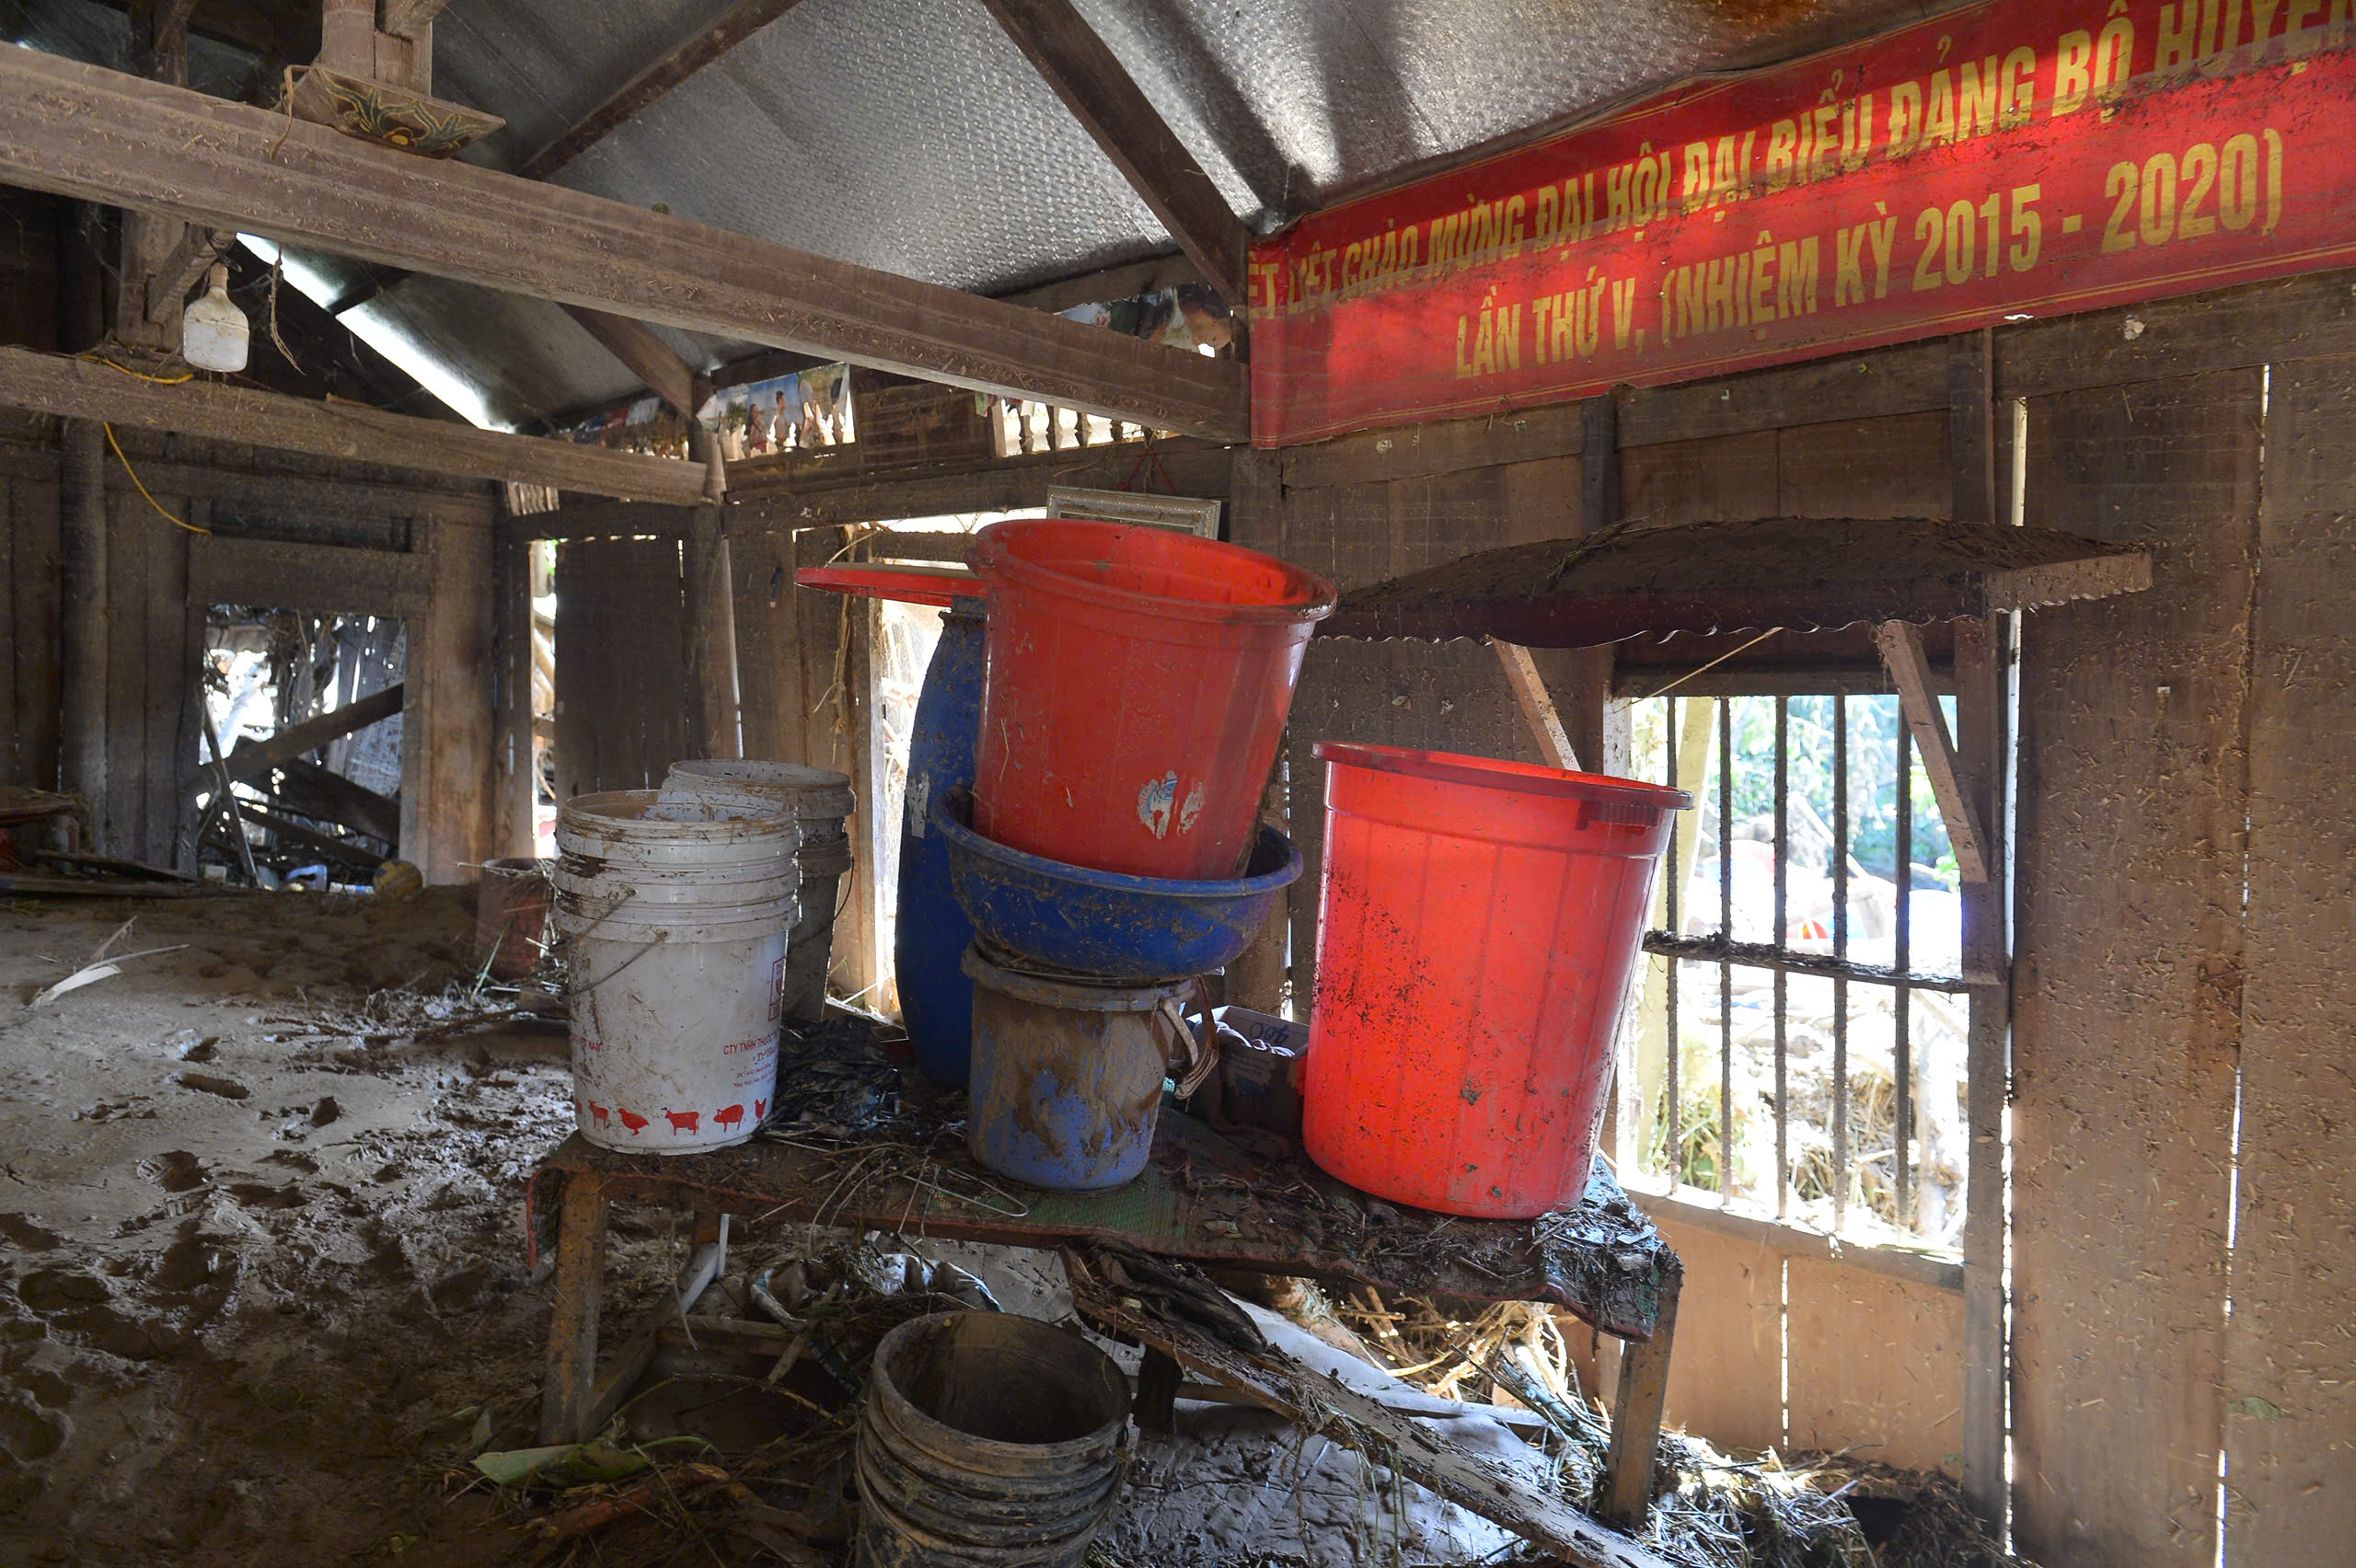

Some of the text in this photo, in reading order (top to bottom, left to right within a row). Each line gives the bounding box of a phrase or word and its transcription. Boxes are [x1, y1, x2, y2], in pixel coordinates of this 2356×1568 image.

[1342, 218, 1418, 301] CHÀO
[1427, 192, 1525, 279] MỪNG
[1534, 172, 1594, 261] ĐẠI
[1604, 141, 1671, 242] HỘI
[1680, 131, 1756, 223] ĐẠI
[1765, 69, 1877, 196] BIỂU
[1887, 35, 2037, 160] ĐẢNG
[2051, 0, 2135, 123] BỘ
[1456, 285, 1520, 379] LẦN
[1532, 266, 1606, 363] THỨ
[1660, 230, 1819, 346] (NHIỆM
[1836, 201, 1898, 307] KỲ
[1912, 184, 2041, 292] 2015
[2063, 214, 2082, 233] -
[2102, 128, 2283, 254] 2020)
